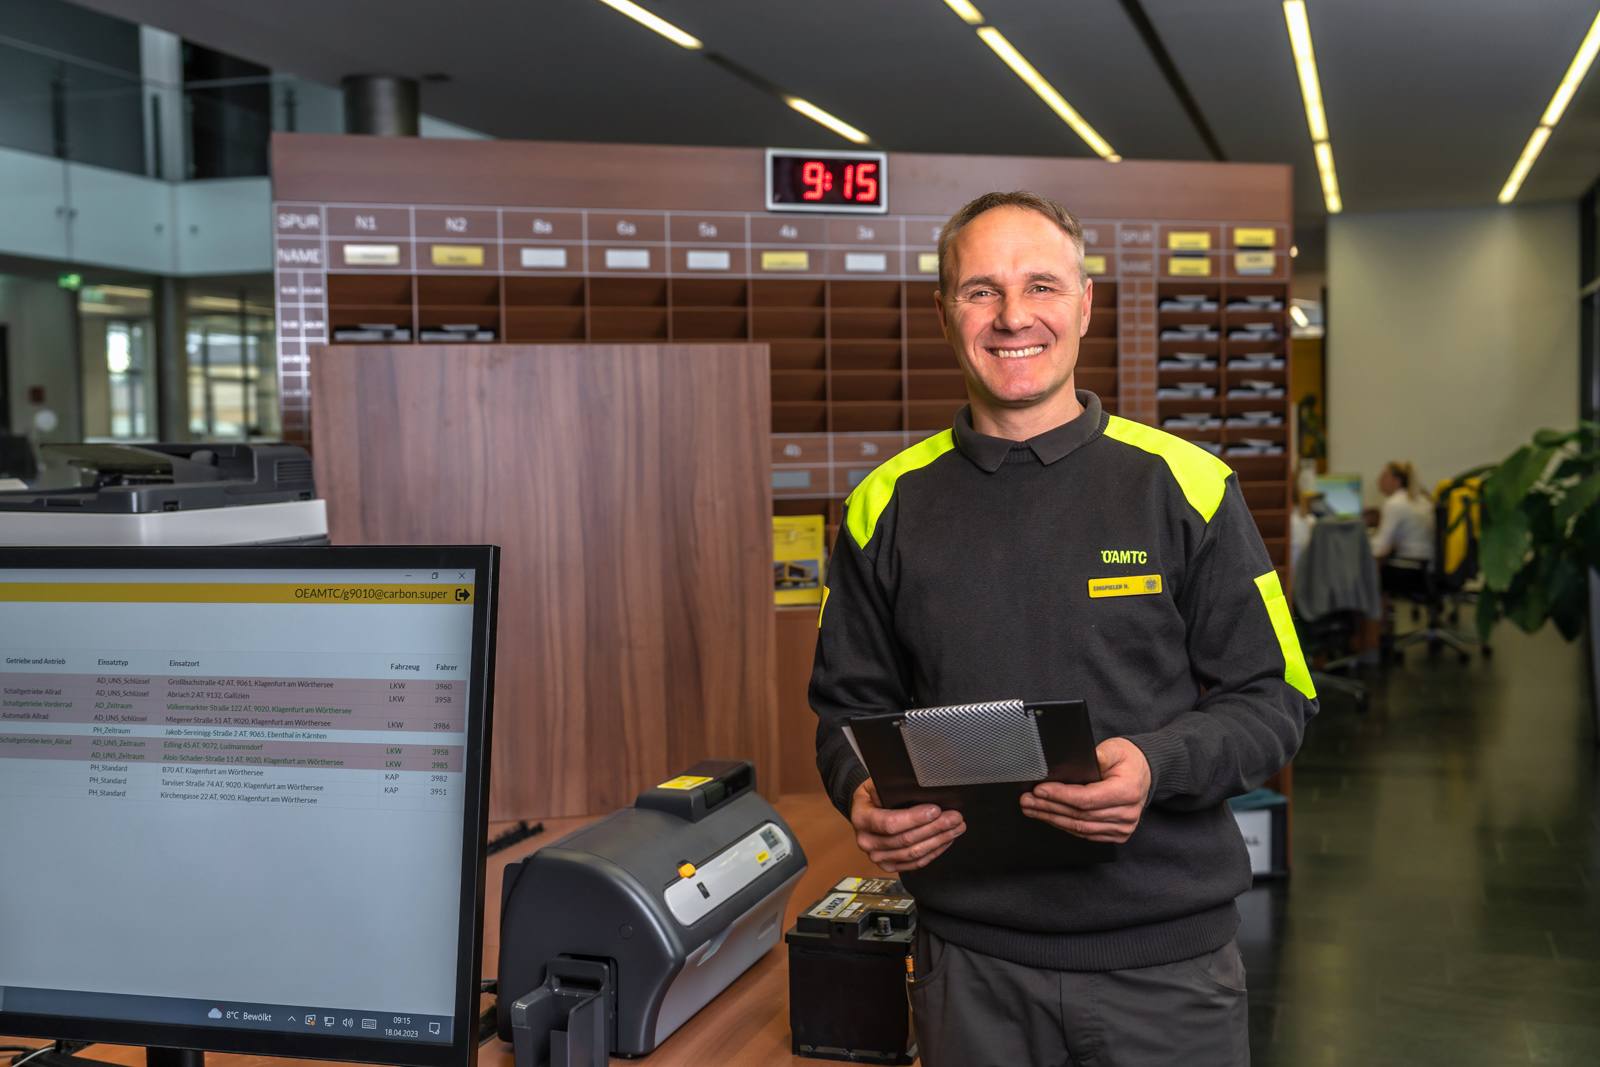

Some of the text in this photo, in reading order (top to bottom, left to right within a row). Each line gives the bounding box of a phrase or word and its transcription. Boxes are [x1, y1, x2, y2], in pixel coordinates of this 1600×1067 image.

[803, 162, 876, 201] 9:15
[278, 213, 320, 230] SPUR
[355, 215, 377, 231] N1
[445, 217, 467, 232] N2
[533, 219, 552, 234] 8a
[617, 220, 636, 236] 6a
[698, 222, 717, 237] 5a
[779, 224, 798, 239] 4a
[857, 225, 875, 240] 3a
[278, 248, 321, 264] NAME
[1101, 550, 1147, 564] ÖAMTC
[294, 588, 448, 600] OEAMTC/g9010@carbon.super
[98, 659, 128, 667] Einsatztyp
[390, 663, 420, 671] Fahrzeug
[96, 678, 150, 686] AD_UNS_Schlüssel
[96, 690, 149, 698] AD_UNS_Schlüssel
[94, 702, 132, 710] AD_Zeitraum
[94, 714, 148, 722] AD_UNS_Schlüssel
[92, 726, 130, 734] PH_Zeitraum
[164, 728, 232, 738] Jakob-Sereinigg-Straße
[92, 739, 146, 748] AD_UNS_Zeitraum
[164, 741, 182, 749] Edling
[90, 752, 144, 760] AD_UNS_Zeitraum
[162, 754, 225, 762] Alois-Schader-Straße
[264, 757, 296, 765] Klagenfurt
[307, 758, 344, 766] Wörthersee
[90, 764, 128, 772] PH_Standard
[90, 776, 126, 784] PH_Standard
[244, 782, 276, 790] Klagenfurt
[88, 789, 126, 797] PH_Standard
[160, 792, 200, 800] Kirchengasse
[238, 794, 270, 802] Klagenfurt
[226, 1010, 272, 1022] 8°C Bewölkt
[393, 1016, 410, 1025] 09:15
[384, 1029, 418, 1038] 18.04.2023
